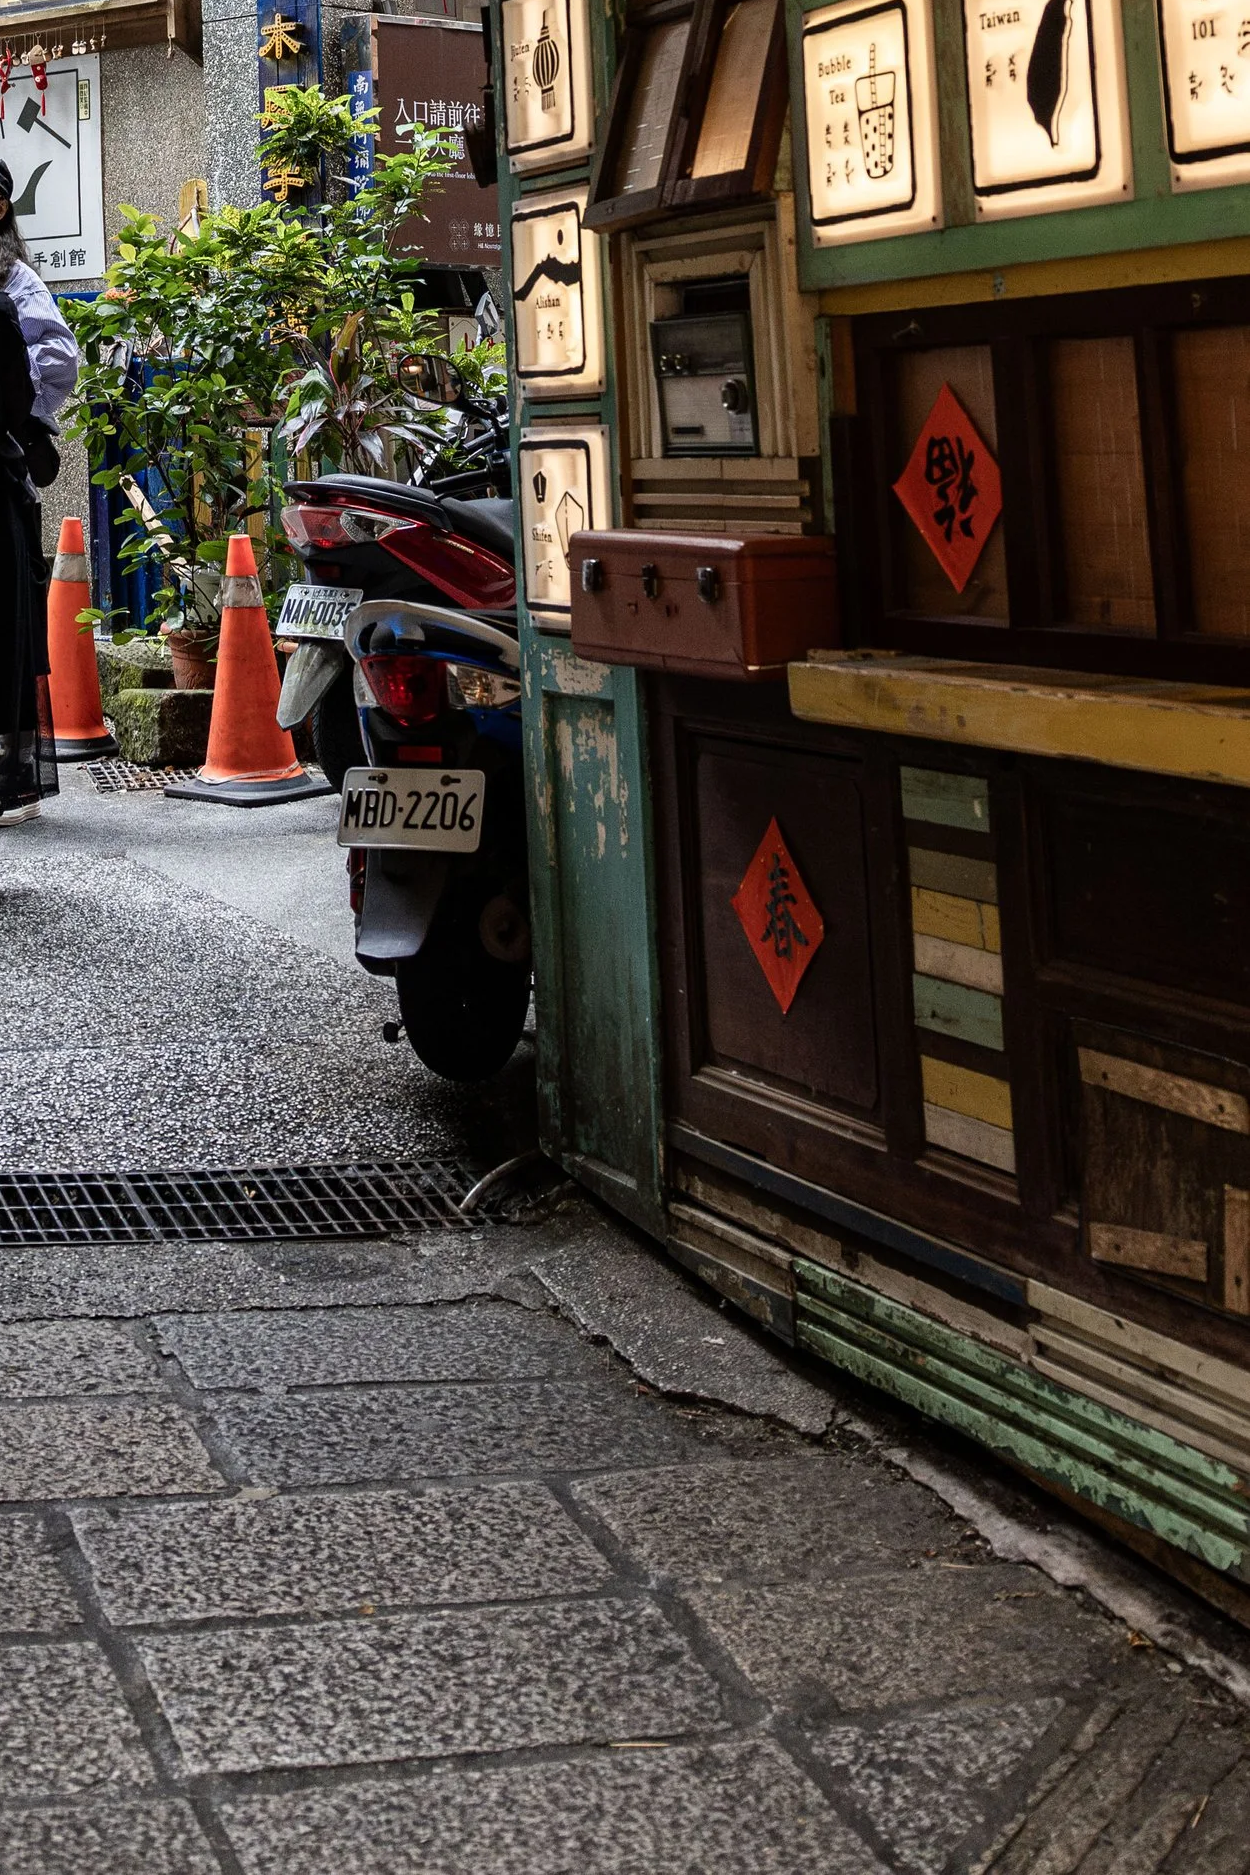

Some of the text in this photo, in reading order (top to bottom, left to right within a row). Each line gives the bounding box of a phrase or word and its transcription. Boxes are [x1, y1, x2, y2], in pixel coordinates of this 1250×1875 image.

[979, 8, 1021, 30] Taiwan
[1191, 20, 1217, 41] 101
[818, 56, 852, 78] Bubble
[829, 90, 846, 106] Tea
[394, 97, 486, 127] 入口請前往
[395, 132, 466, 160] 一大廳
[33, 248, 87, 269] 手創館
[535, 295, 561, 310] Alishan
[532, 528, 553, 544] Shifen
[761, 852, 810, 961] 春
